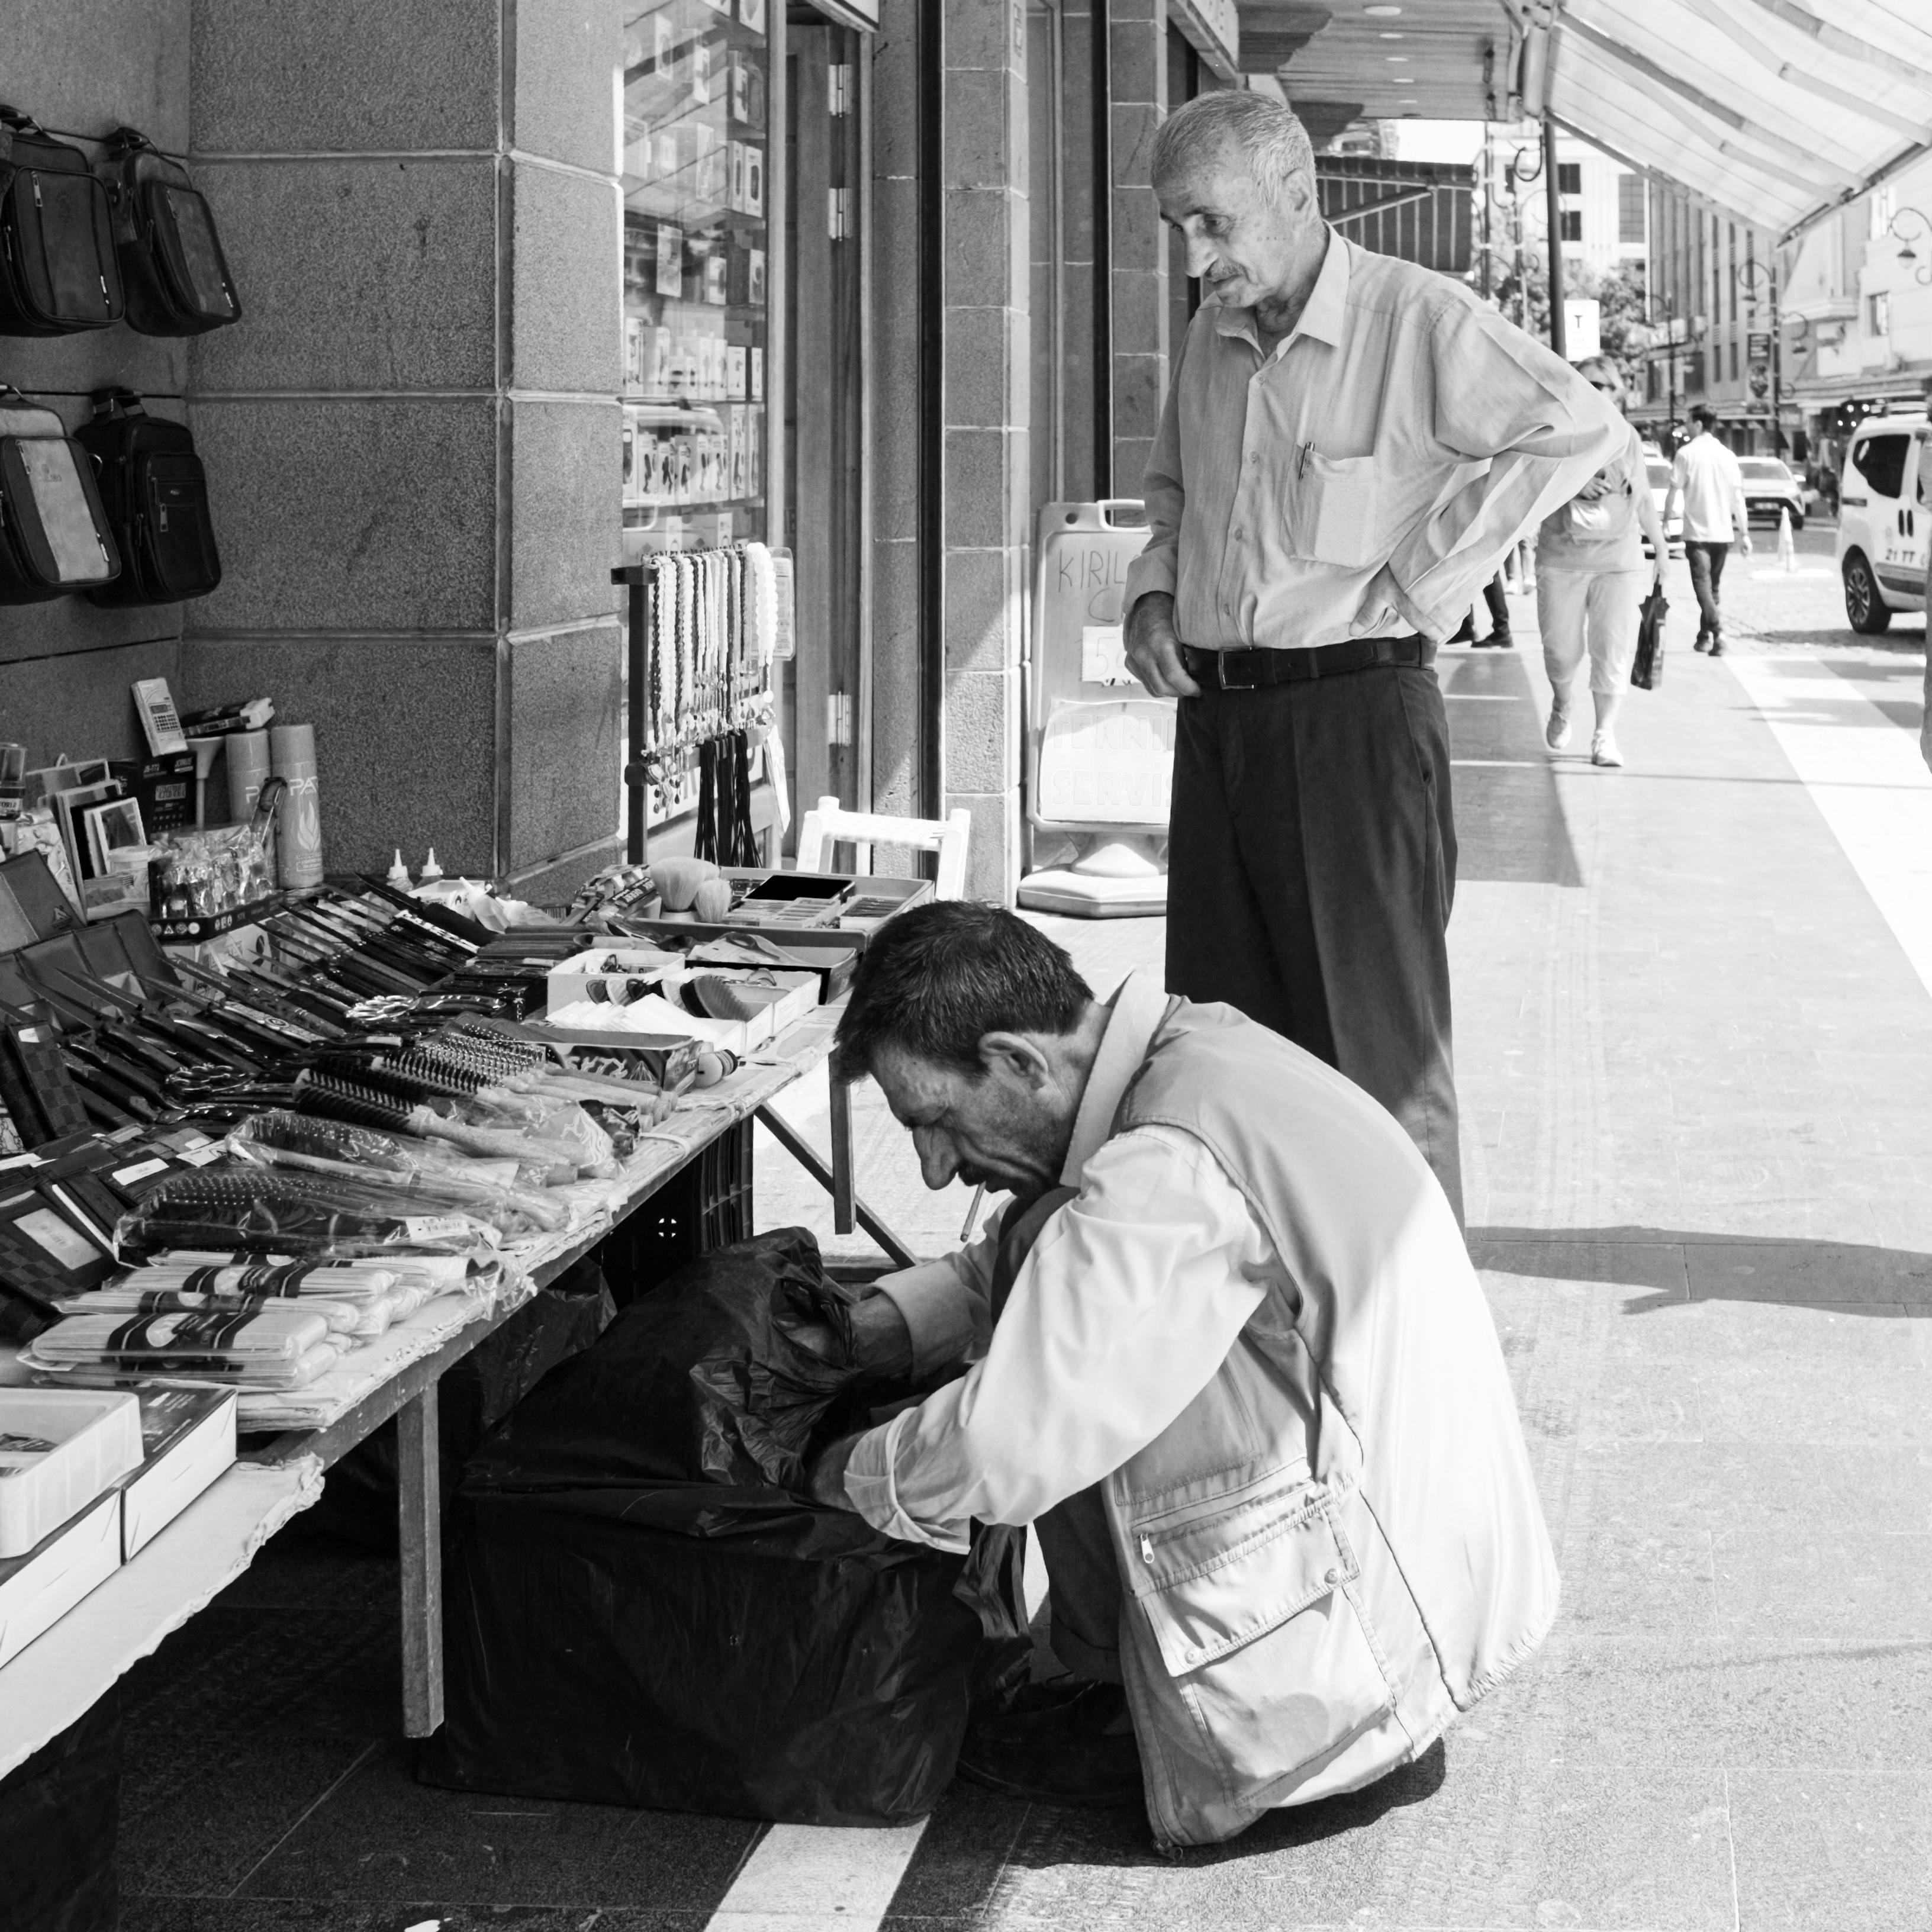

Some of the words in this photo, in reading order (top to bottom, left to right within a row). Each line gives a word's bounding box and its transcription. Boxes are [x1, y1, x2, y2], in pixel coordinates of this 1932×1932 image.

[1574, 314, 1583, 329] T
[1058, 548, 1138, 593] KIRIL
[1902, 550, 1915, 564] TT
[1052, 762, 1173, 807] SERVİ
